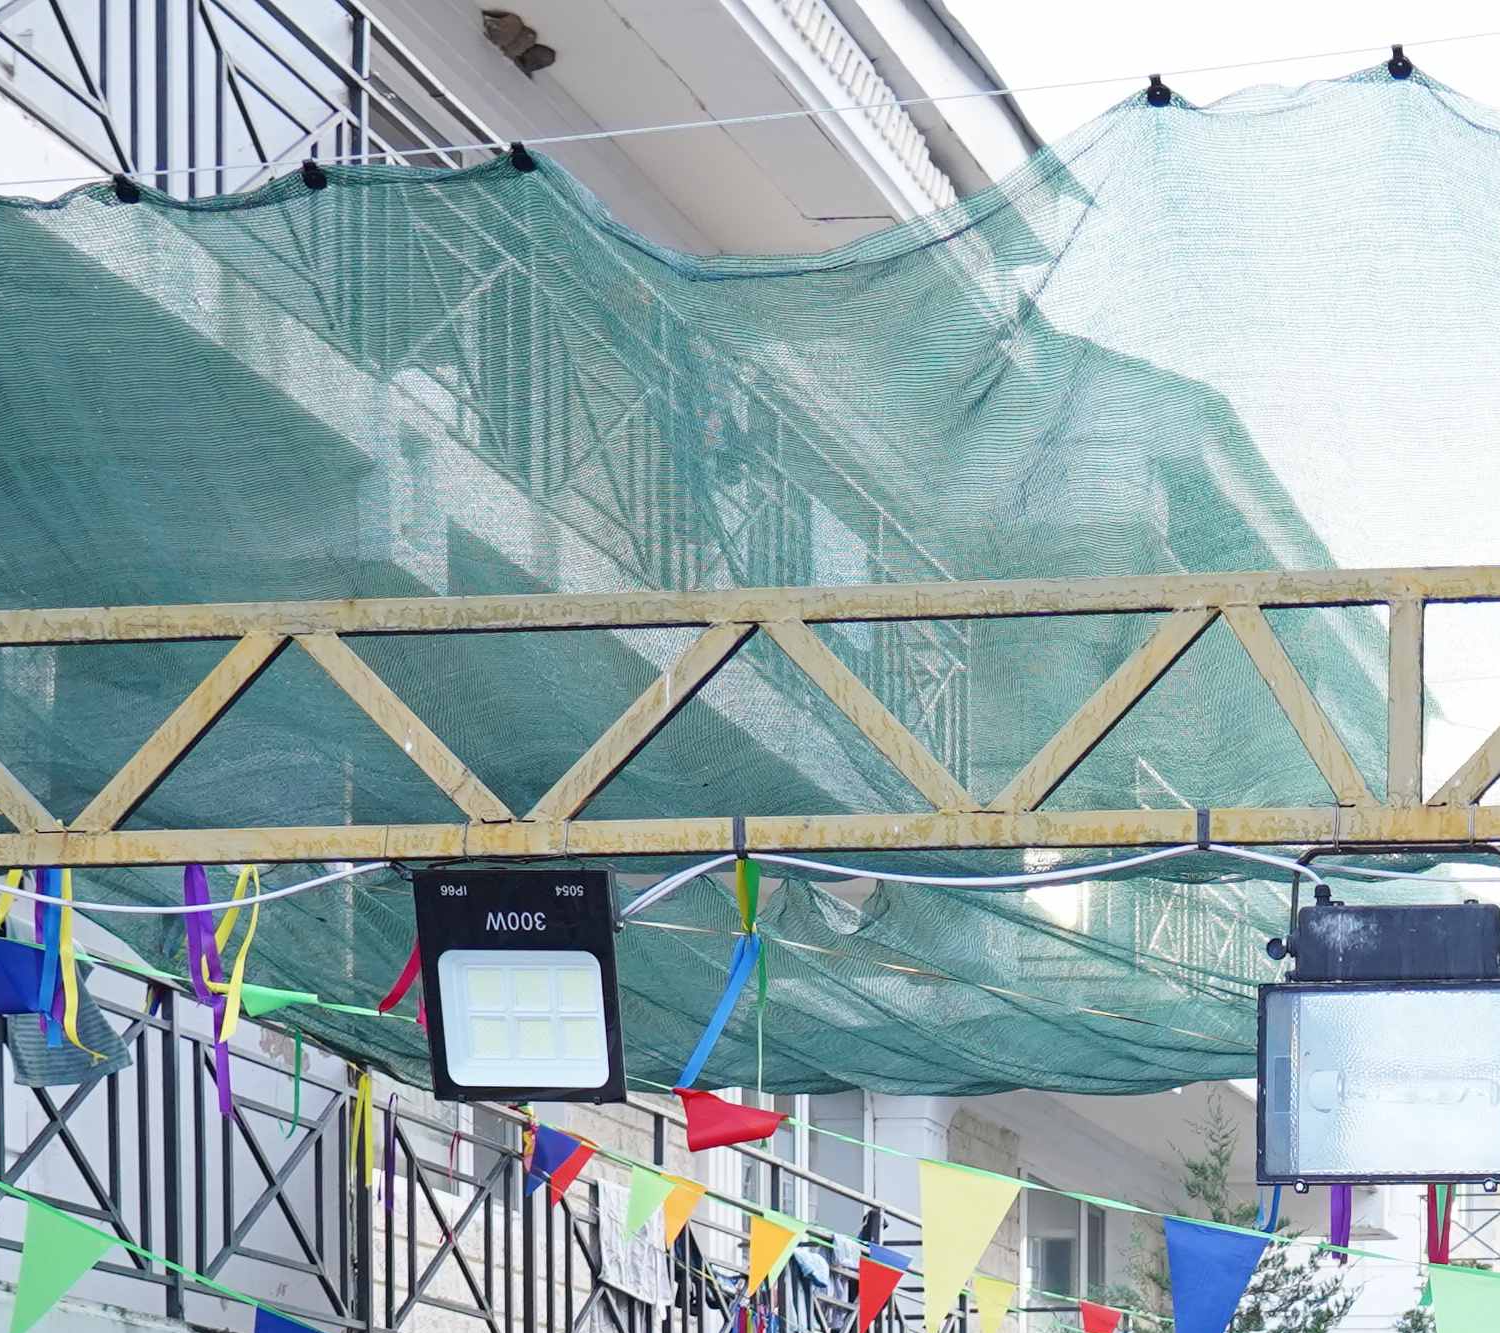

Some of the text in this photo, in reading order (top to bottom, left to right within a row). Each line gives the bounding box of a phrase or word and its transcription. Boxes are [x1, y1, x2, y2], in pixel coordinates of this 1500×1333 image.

[440, 884, 467, 896] IP66
[555, 884, 584, 897] 5054
[486, 911, 547, 931] 300W
